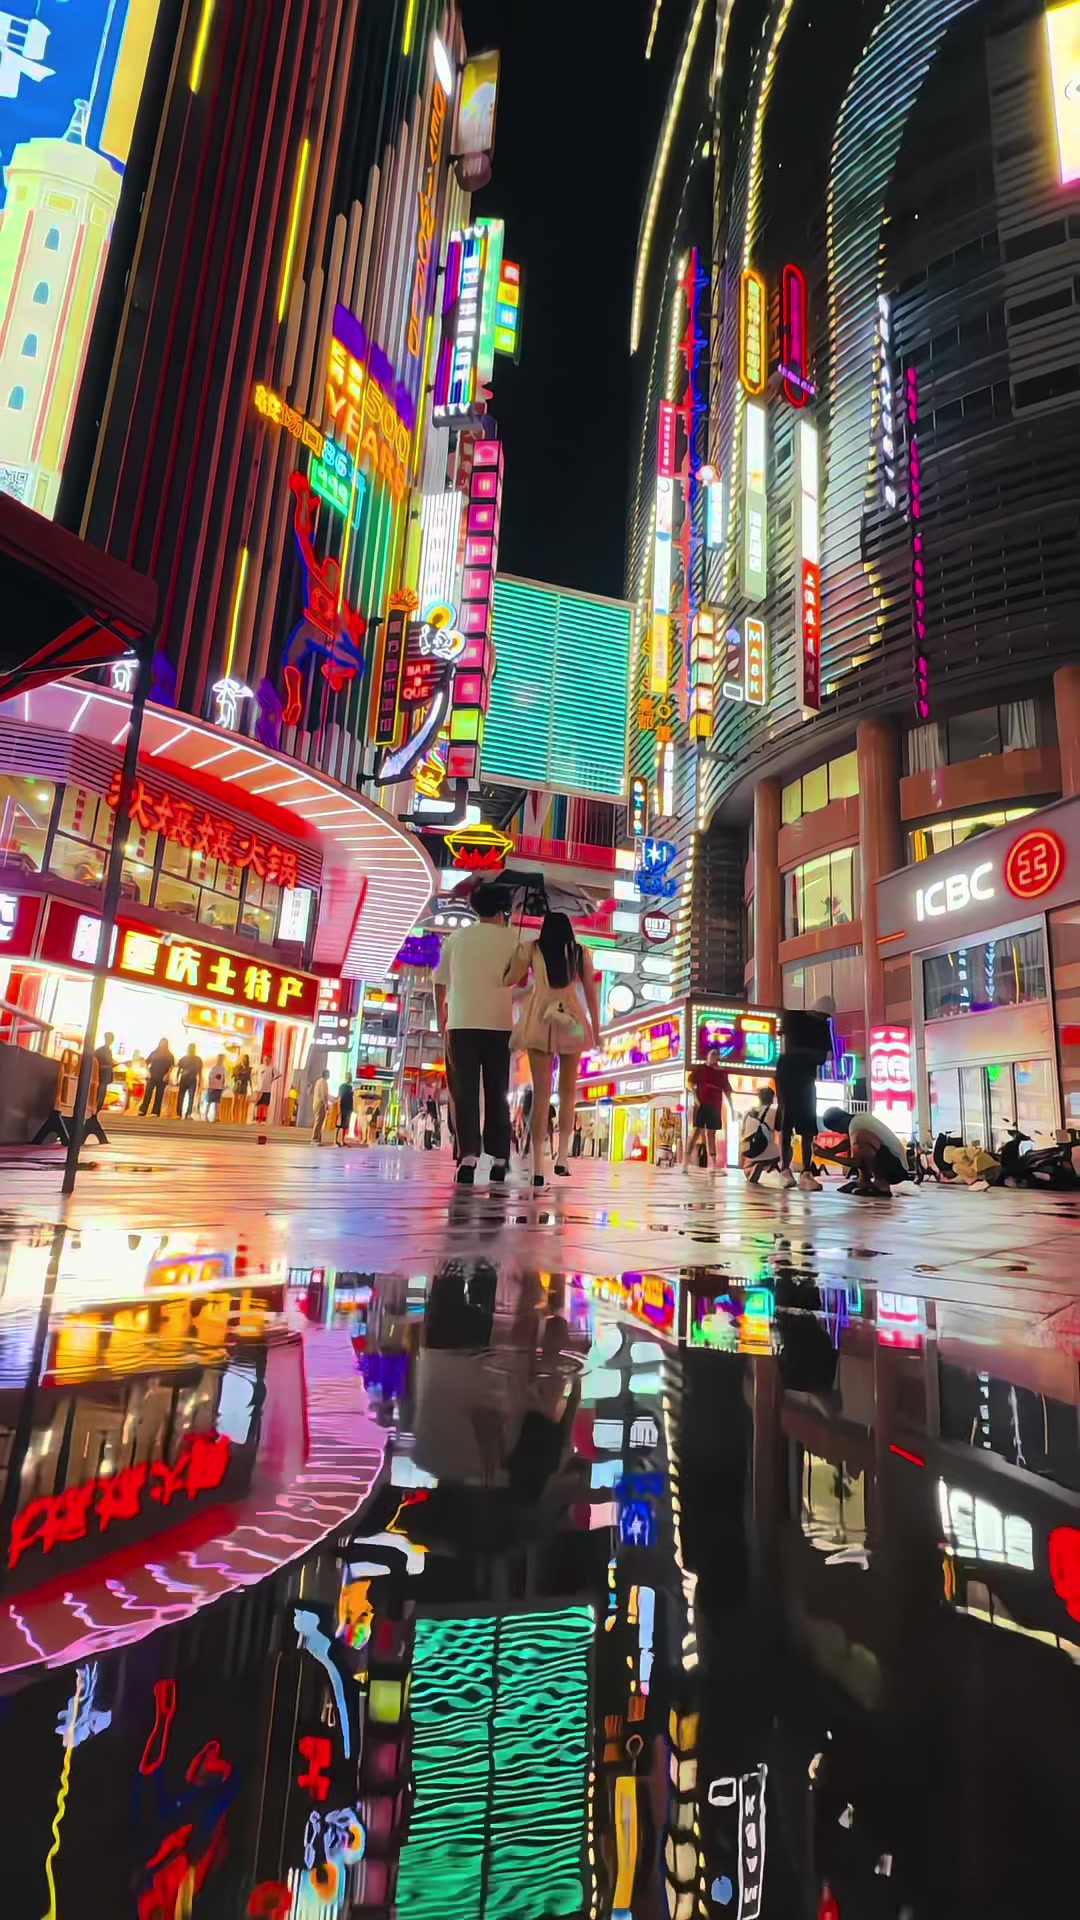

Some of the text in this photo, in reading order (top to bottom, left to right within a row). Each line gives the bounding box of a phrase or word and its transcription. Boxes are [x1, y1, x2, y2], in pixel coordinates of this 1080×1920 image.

[364, 380, 411, 462] 500
[434, 402, 470, 417] KTV
[326, 384, 403, 498] YEARS
[312, 458, 349, 507] 1999
[403, 687, 429, 700] QUE
[406, 663, 431, 677] BAR
[414, 676, 422, 687] B
[915, 861, 995, 922] ICBC
[119, 929, 304, 1008] 重庆土特产
